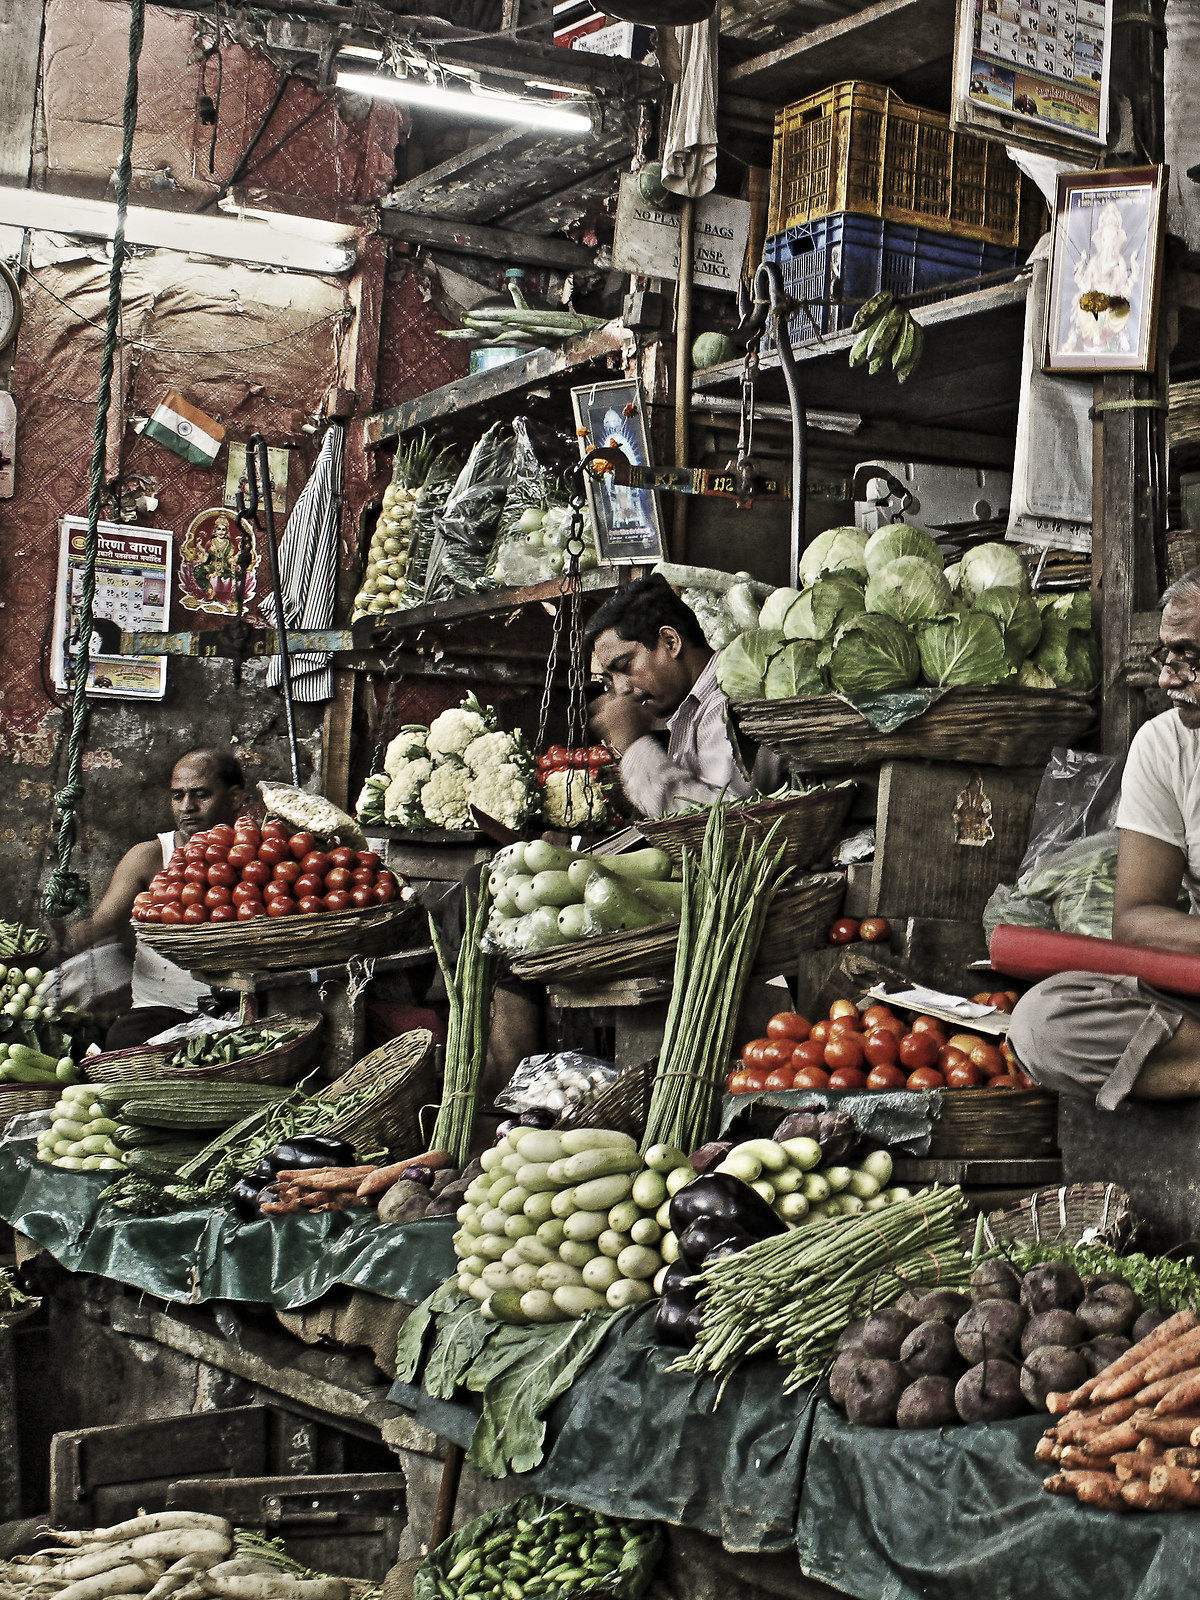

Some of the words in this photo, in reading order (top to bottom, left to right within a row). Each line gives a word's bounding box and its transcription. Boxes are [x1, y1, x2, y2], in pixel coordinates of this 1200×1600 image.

[634, 208, 651, 219] NO
[705, 223, 735, 238] BAGS
[697, 248, 725, 262] INSP.
[701, 263, 730, 277] MKT.
[97, 534, 126, 552] ोरणा
[128, 542, 163, 556] वारणा
